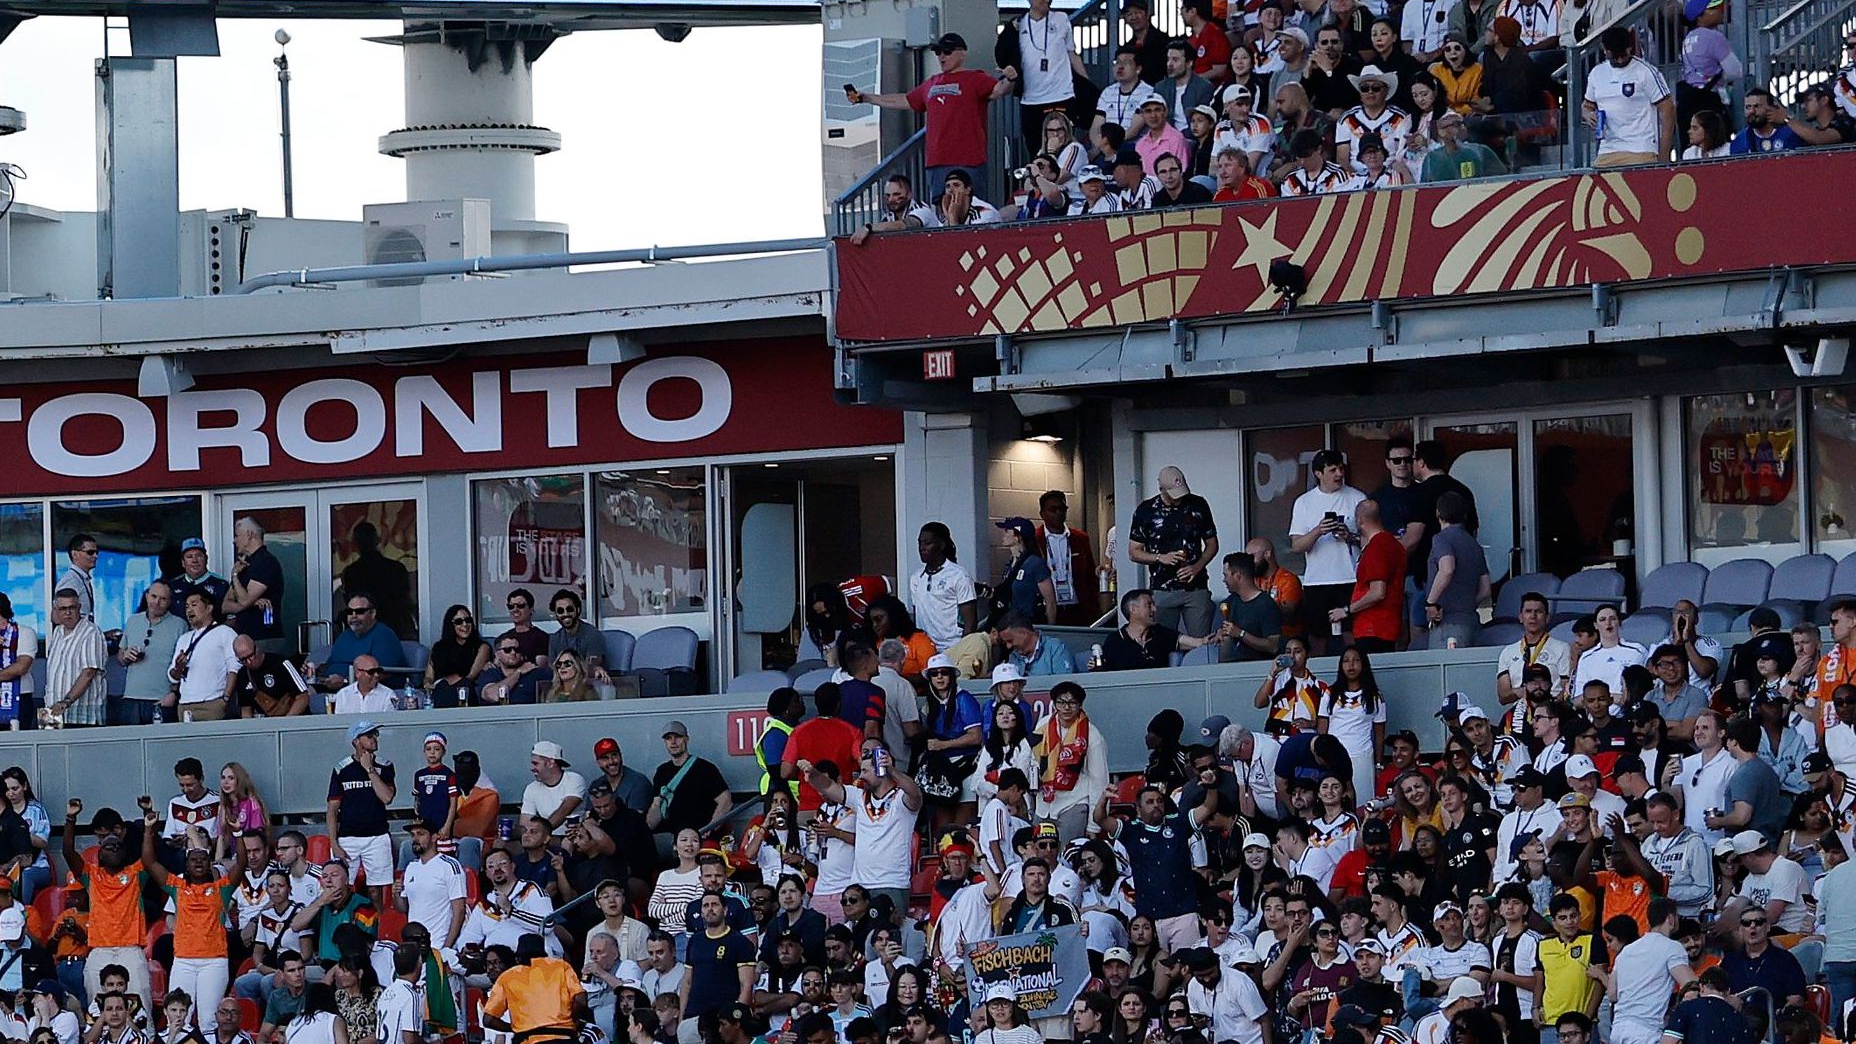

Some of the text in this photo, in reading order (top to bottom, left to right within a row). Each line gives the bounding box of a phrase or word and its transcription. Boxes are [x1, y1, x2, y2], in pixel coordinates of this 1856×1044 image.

[927, 351, 952, 378] EXIT
[516, 529, 539, 542] THE
[516, 541, 527, 555] IS
[972, 945, 1052, 975] FISCHBACH
